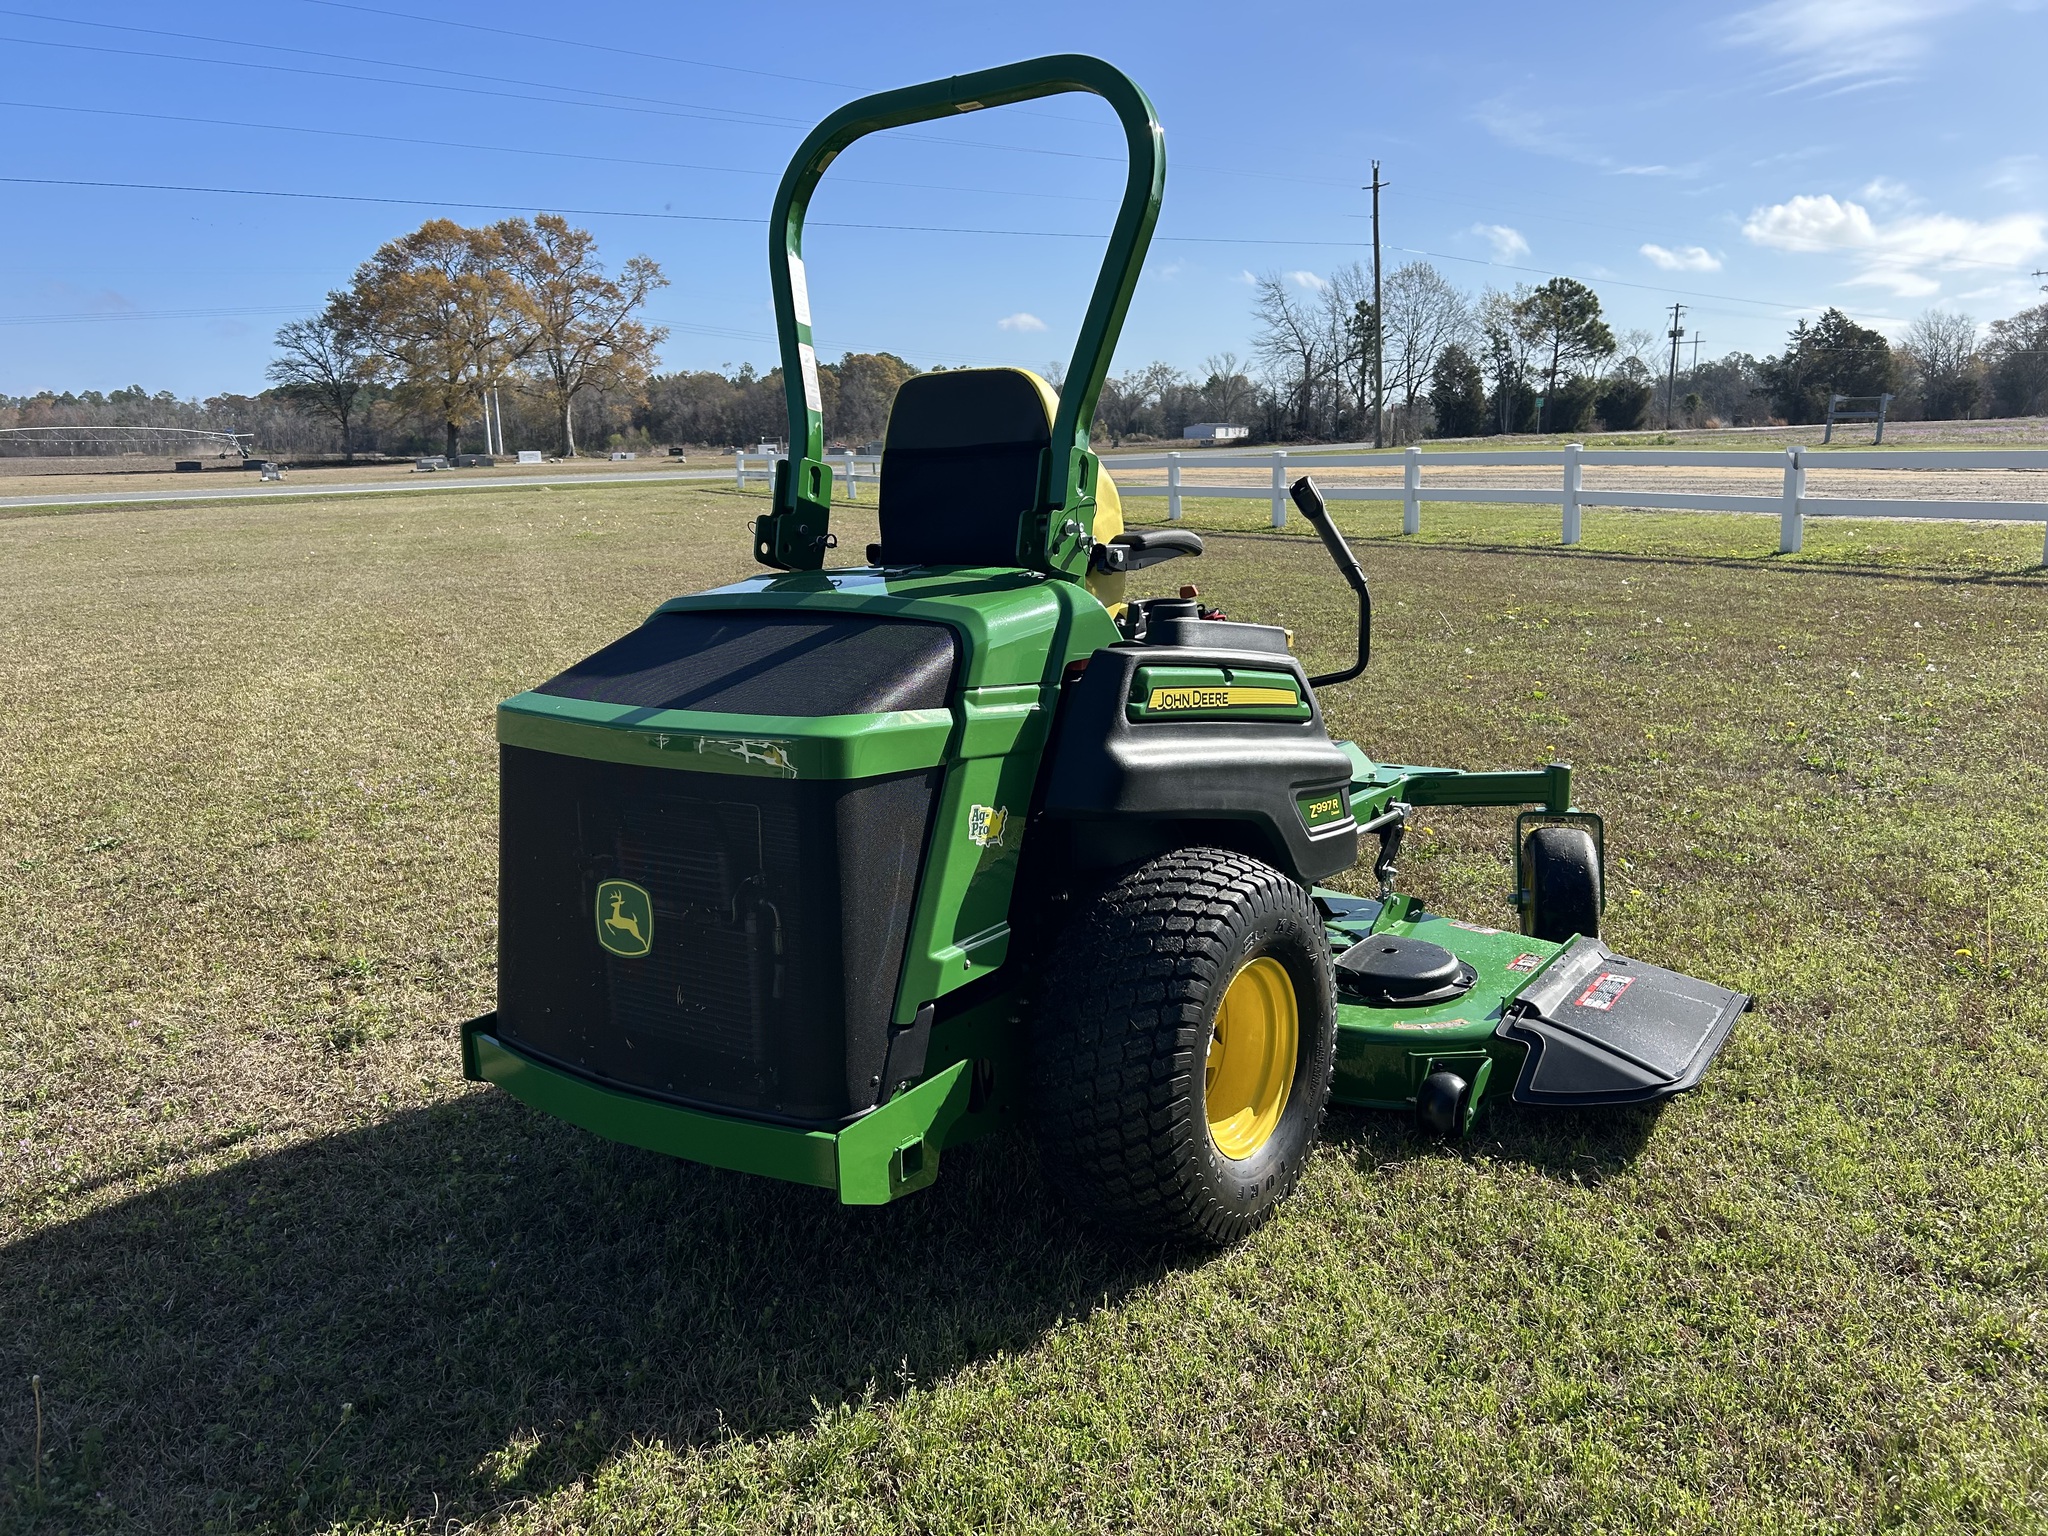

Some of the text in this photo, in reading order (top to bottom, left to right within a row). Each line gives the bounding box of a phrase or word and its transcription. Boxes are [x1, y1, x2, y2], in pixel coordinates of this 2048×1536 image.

[1157, 690, 1229, 708] JOHN DEERE
[1309, 798, 1339, 819] Z997R
[971, 823, 989, 836] Pro
[1236, 1161, 1288, 1202] TURF
